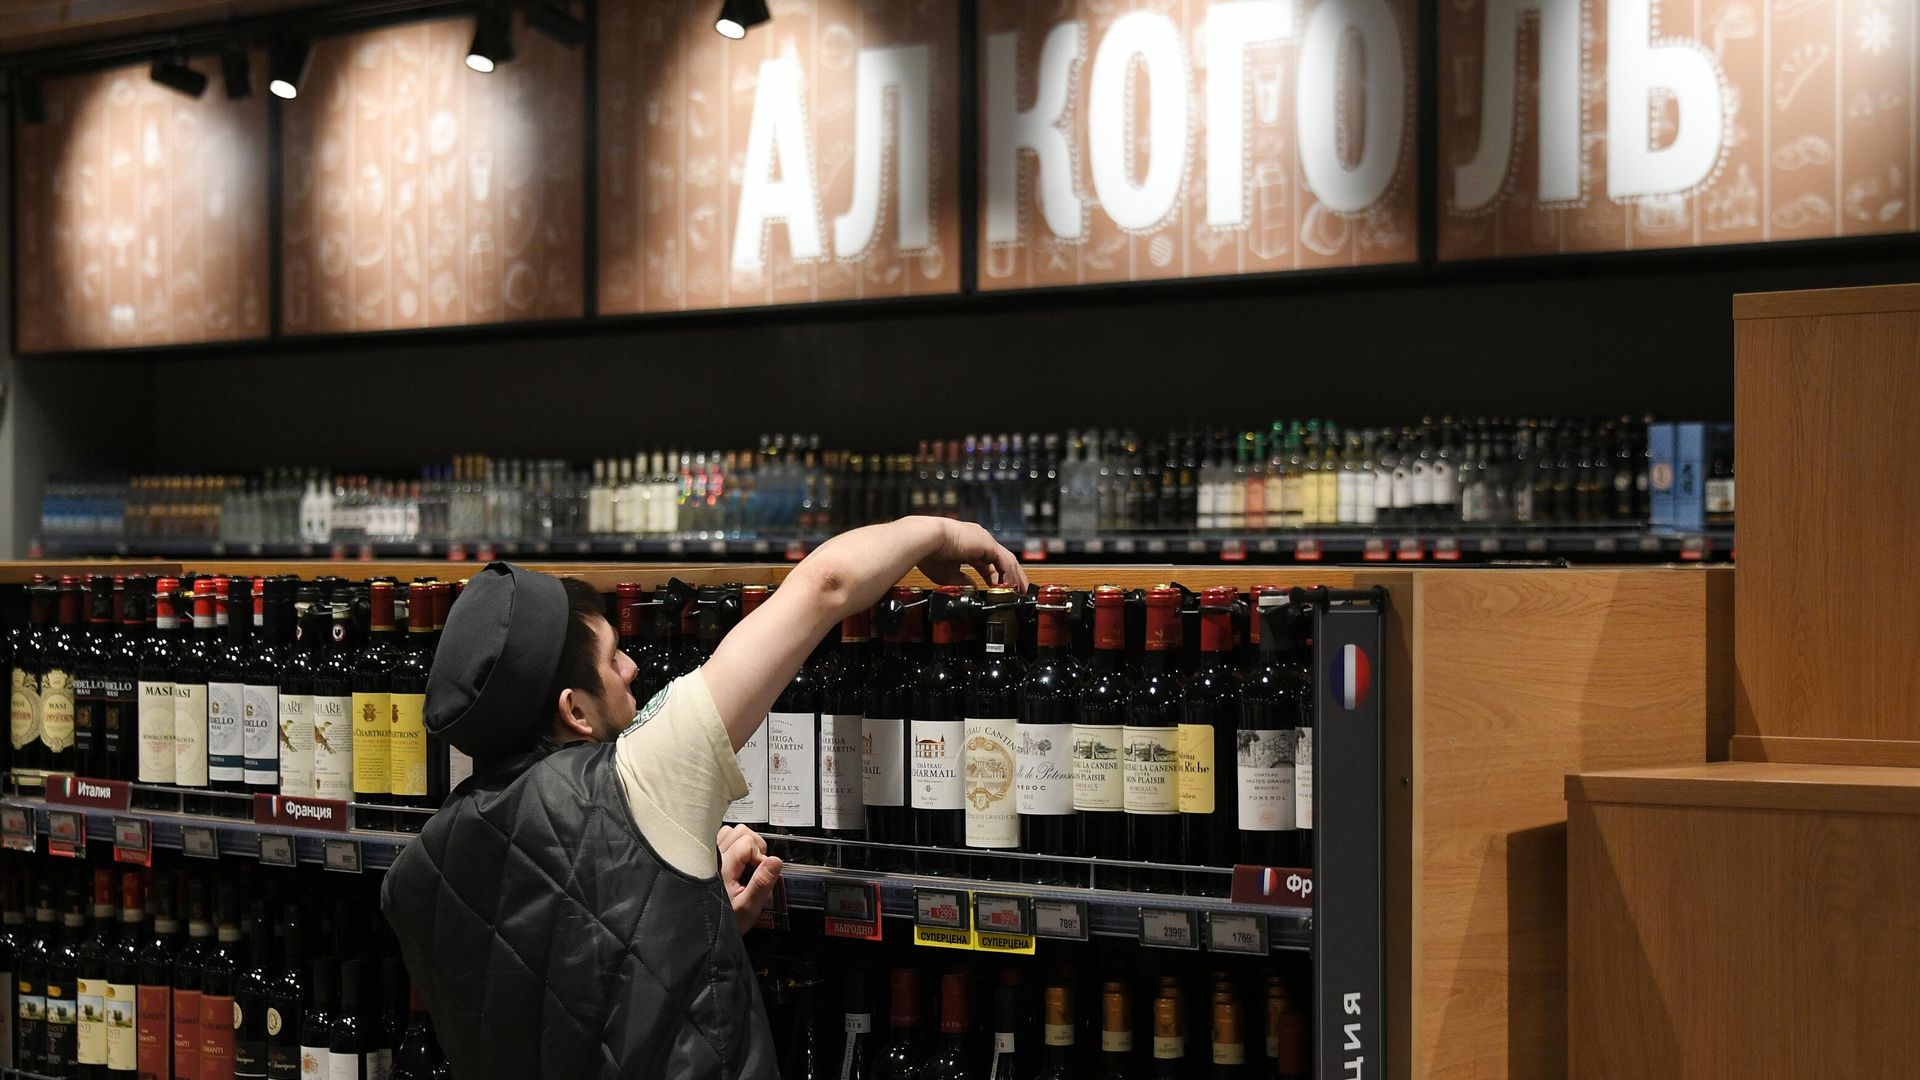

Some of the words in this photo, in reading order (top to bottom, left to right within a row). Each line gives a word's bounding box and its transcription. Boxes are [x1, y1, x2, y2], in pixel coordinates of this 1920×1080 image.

[731, 0, 1729, 270] АЛКОГОЛЬ
[145, 686, 173, 696] MASI
[1139, 764, 1148, 772] LA
[1184, 761, 1210, 774] Riche
[1137, 776, 1166, 784] PLAISIR
[78, 781, 111, 799] Италия
[285, 801, 332, 821] Франция
[834, 922, 874, 936] ВЫГОДНО
[1059, 918, 1073, 929] 789
[920, 932, 968, 945] СУПЕРЦЕНА
[1163, 926, 1182, 938] 2399
[981, 937, 1030, 950] СУПЕРЦЕНА
